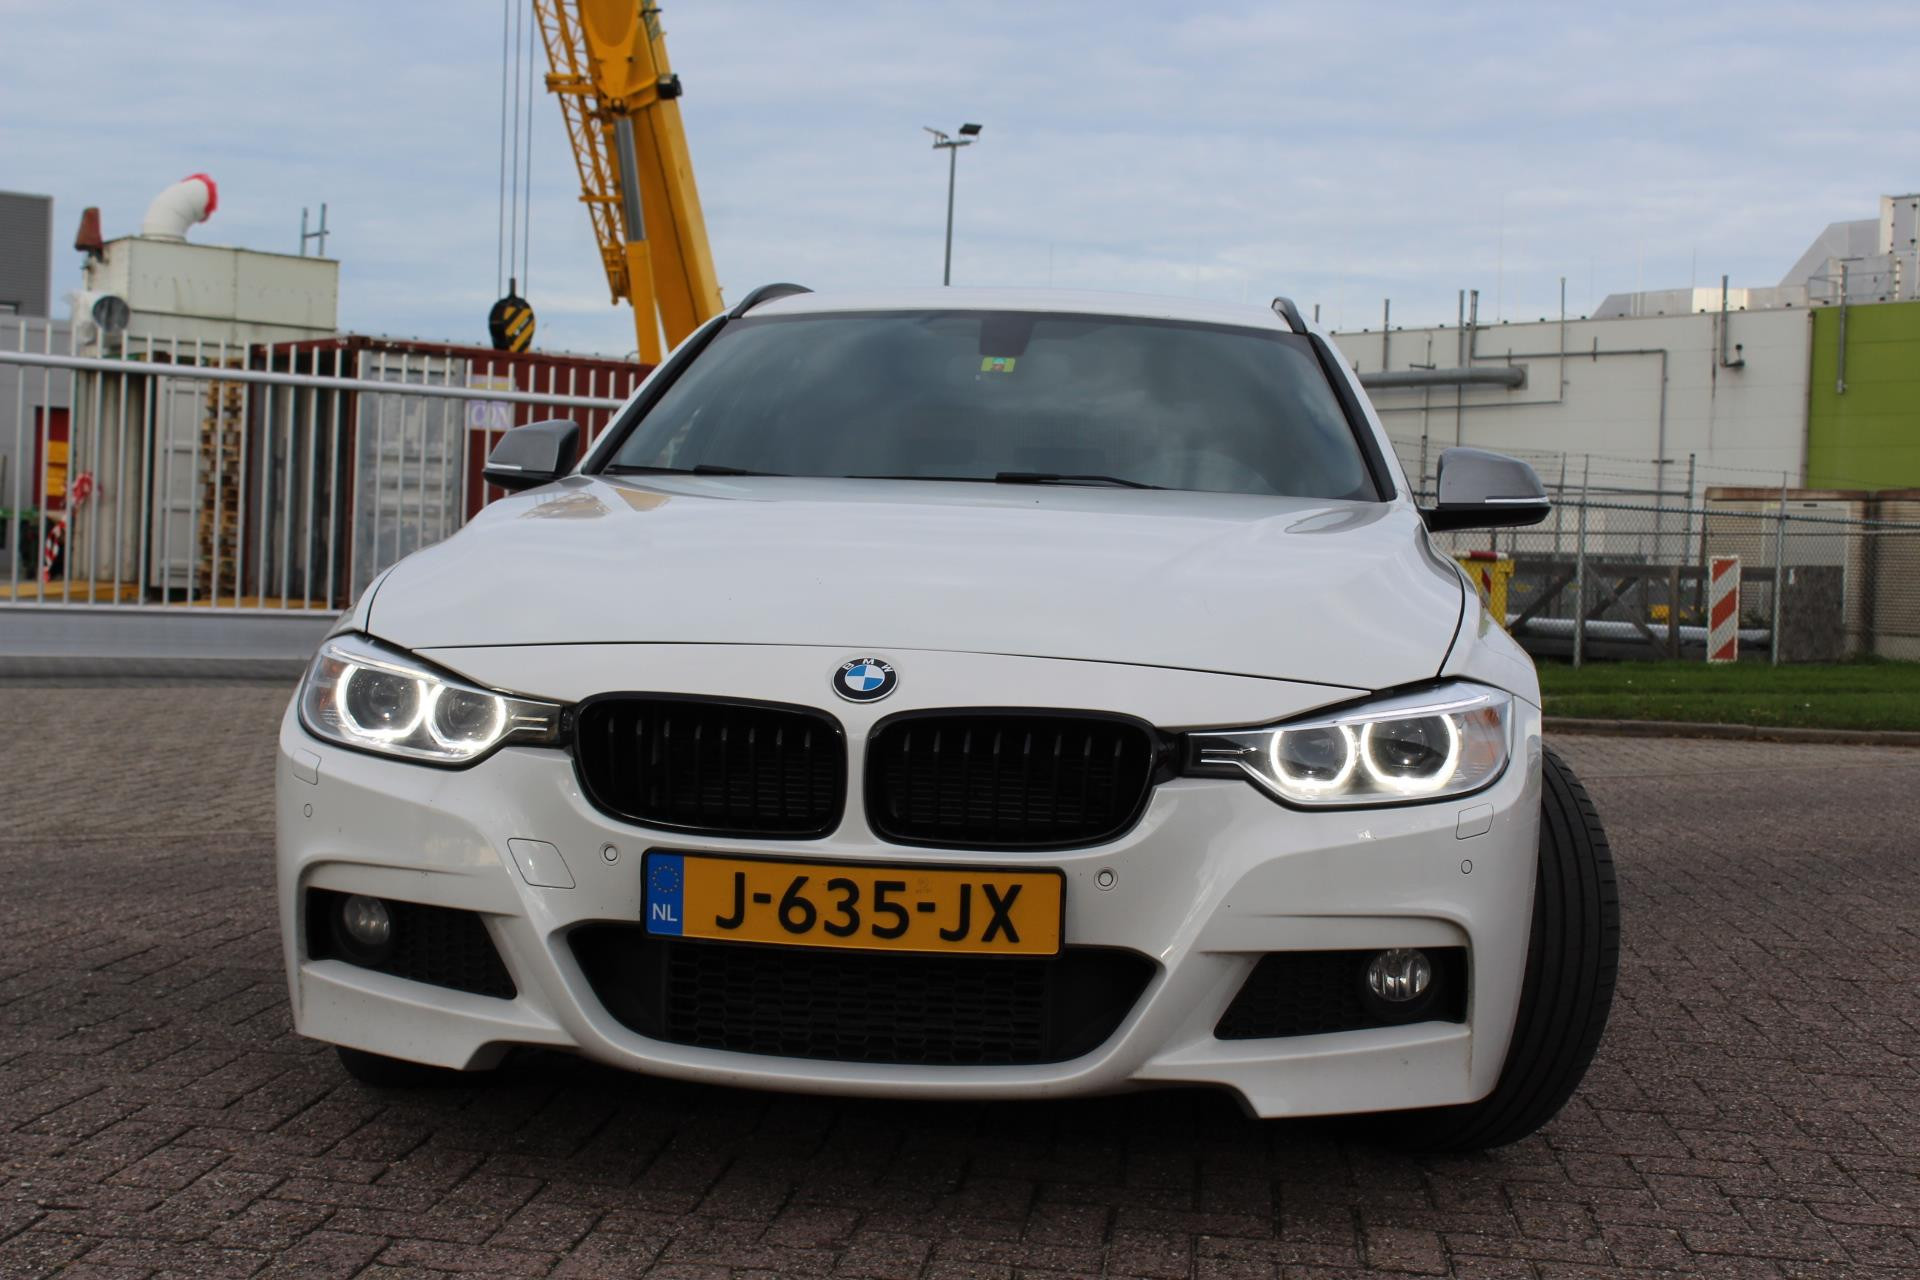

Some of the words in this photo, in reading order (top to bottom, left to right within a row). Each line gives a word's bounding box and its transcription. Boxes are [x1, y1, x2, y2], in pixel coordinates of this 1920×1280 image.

[842, 658, 894, 673] BMW
[651, 902, 678, 922] NL
[714, 871, 1024, 944] J-635-JX
